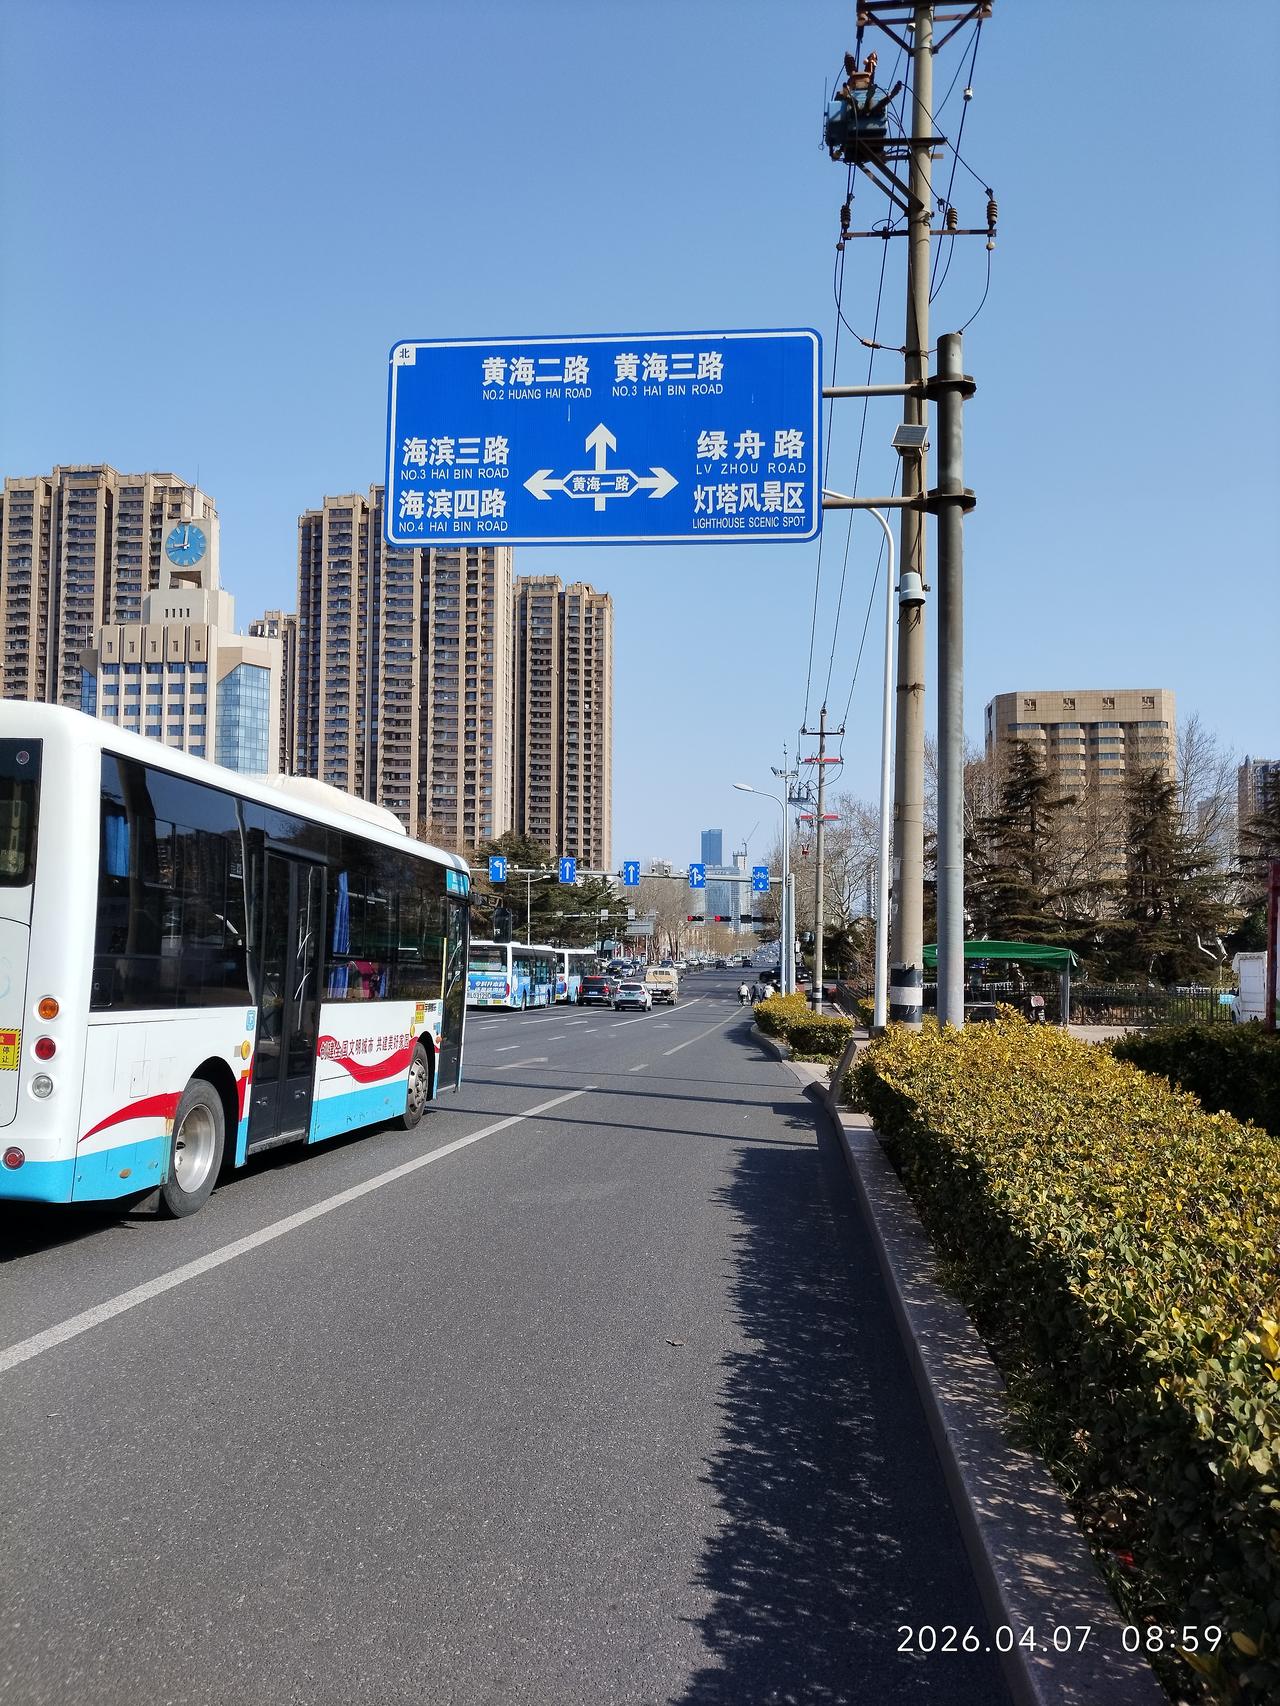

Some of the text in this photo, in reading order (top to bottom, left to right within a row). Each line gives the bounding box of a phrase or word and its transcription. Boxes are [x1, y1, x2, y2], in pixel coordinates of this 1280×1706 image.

[399, 347, 410, 359] 北
[482, 356, 589, 386] 黄海二路
[614, 351, 723, 382] 黄海三路
[483, 388, 591, 399] NO.2 HUANG HAI ROAD
[613, 384, 723, 396] NO.3 HAI BIN ROAD
[403, 436, 509, 466] 海滨三路
[697, 429, 805, 460] 绿舟路
[401, 468, 509, 480] NO.3 HAI BIN ROAD
[697, 463, 805, 474] LV ZHOU ROAD
[572, 476, 630, 492] 黄海一路
[399, 488, 506, 519] 海滨四路
[694, 481, 805, 514] 灯塔风景区
[399, 521, 507, 532] NO.4 HAI BIN ROAD
[693, 516, 805, 528] LIGHTHOUSE SCENIC SPOT
